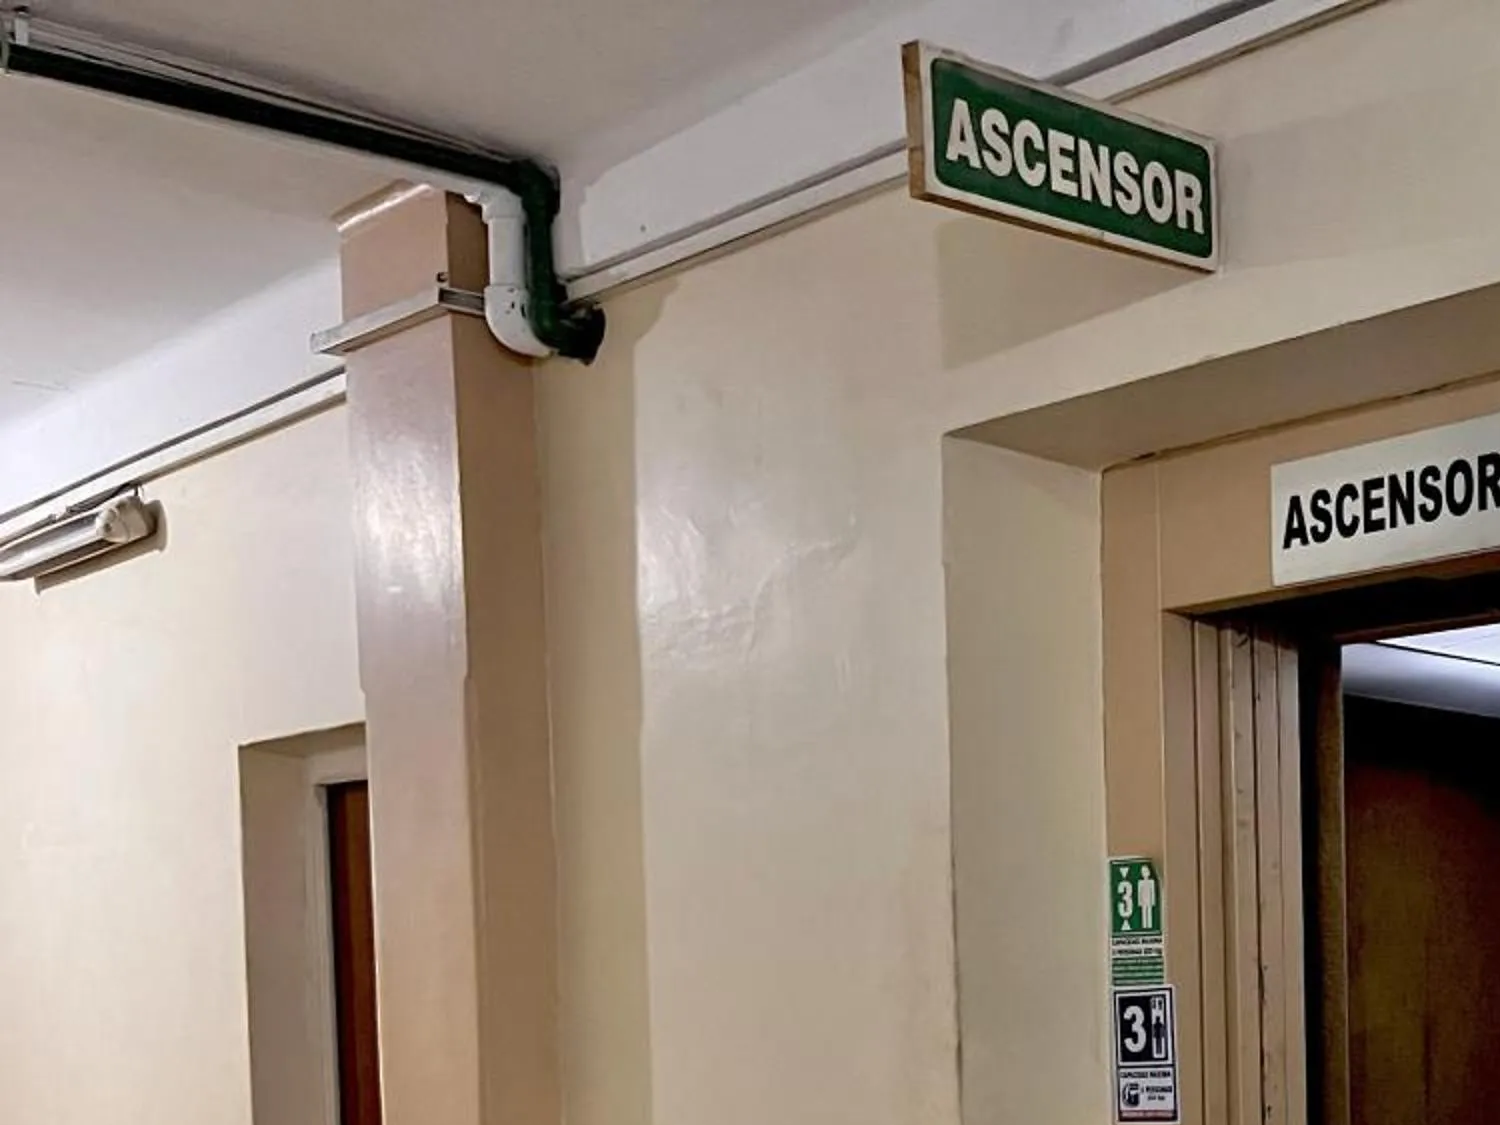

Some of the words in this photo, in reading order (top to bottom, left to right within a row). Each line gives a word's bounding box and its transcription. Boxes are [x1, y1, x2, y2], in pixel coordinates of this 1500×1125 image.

[946, 98, 1204, 235] ASCENSOR
[1117, 881, 1133, 917] 3
[1123, 1005, 1146, 1053] 3
